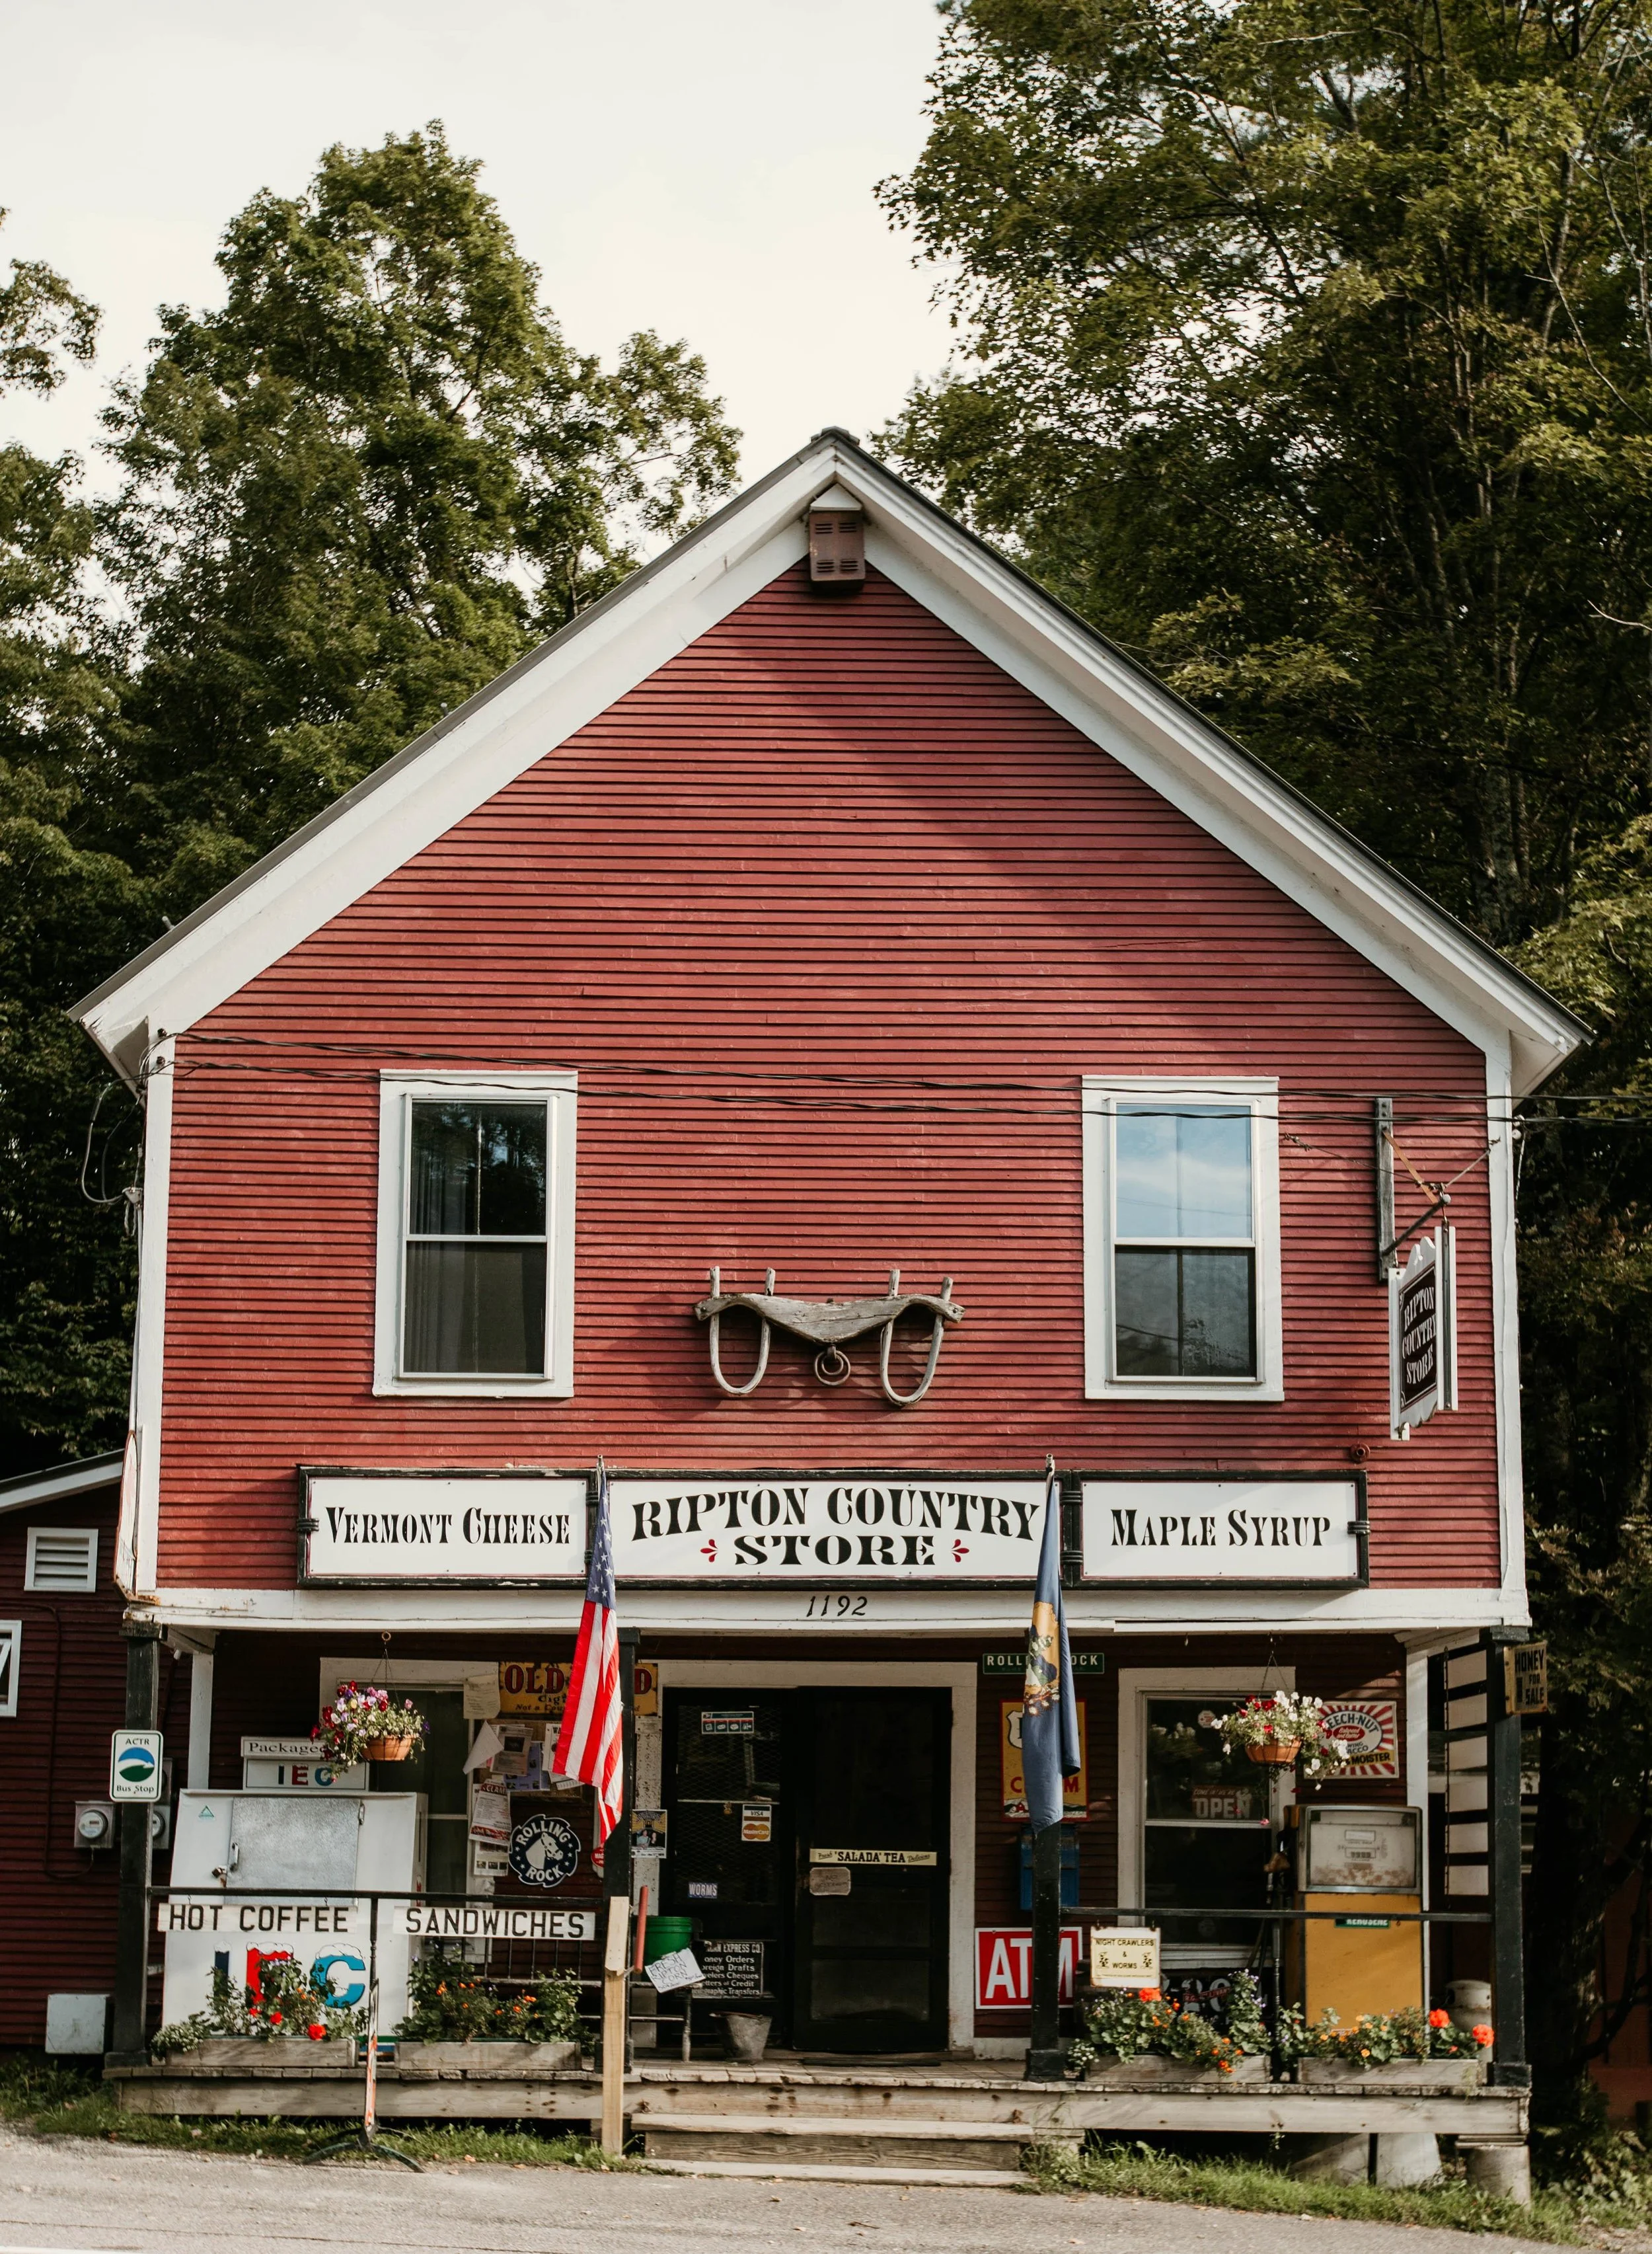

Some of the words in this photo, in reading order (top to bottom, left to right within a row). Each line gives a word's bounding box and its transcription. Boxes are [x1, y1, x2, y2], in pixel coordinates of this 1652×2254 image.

[1404, 1287, 1434, 1332] RIPTON
[1402, 1313, 1436, 1359] COUNTRY
[1406, 1343, 1433, 1384] STORE
[326, 1506, 452, 1545] VERMONT
[463, 1507, 570, 1545] CHEESE
[632, 1487, 809, 1541] RIPTON
[827, 1487, 1039, 1541] COUNTRY
[1111, 1509, 1216, 1546] MAPLE
[1228, 1509, 1331, 1547] SYRUP
[735, 1535, 934, 1565] STORE
[806, 1595, 868, 1617] 1192
[1515, 1649, 1544, 1672] HONEY
[504, 1664, 565, 1694] OLD
[1529, 1674, 1540, 1685] FOR
[1525, 1687, 1544, 1705] SALE
[249, 1742, 325, 1755] Package
[1351, 1752, 1390, 1764] MOISTER
[135, 1785, 154, 1794] Stop
[1191, 1797, 1250, 1818] OPEN
[515, 1820, 572, 1846] ROLLING
[883, 1853, 906, 1863] TEA
[525, 1864, 564, 1881] ROCK
[689, 1883, 718, 1896] WORMS
[169, 1904, 223, 1931] HOT
[239, 1905, 349, 1933] COFFEE
[406, 1908, 584, 1938] SANDWICHES
[723, 1944, 750, 1953] EXPRESS
[649, 1953, 683, 1977] FRESH
[727, 1972, 759, 1981] Cheques
[985, 1937, 1073, 1999] ATM
